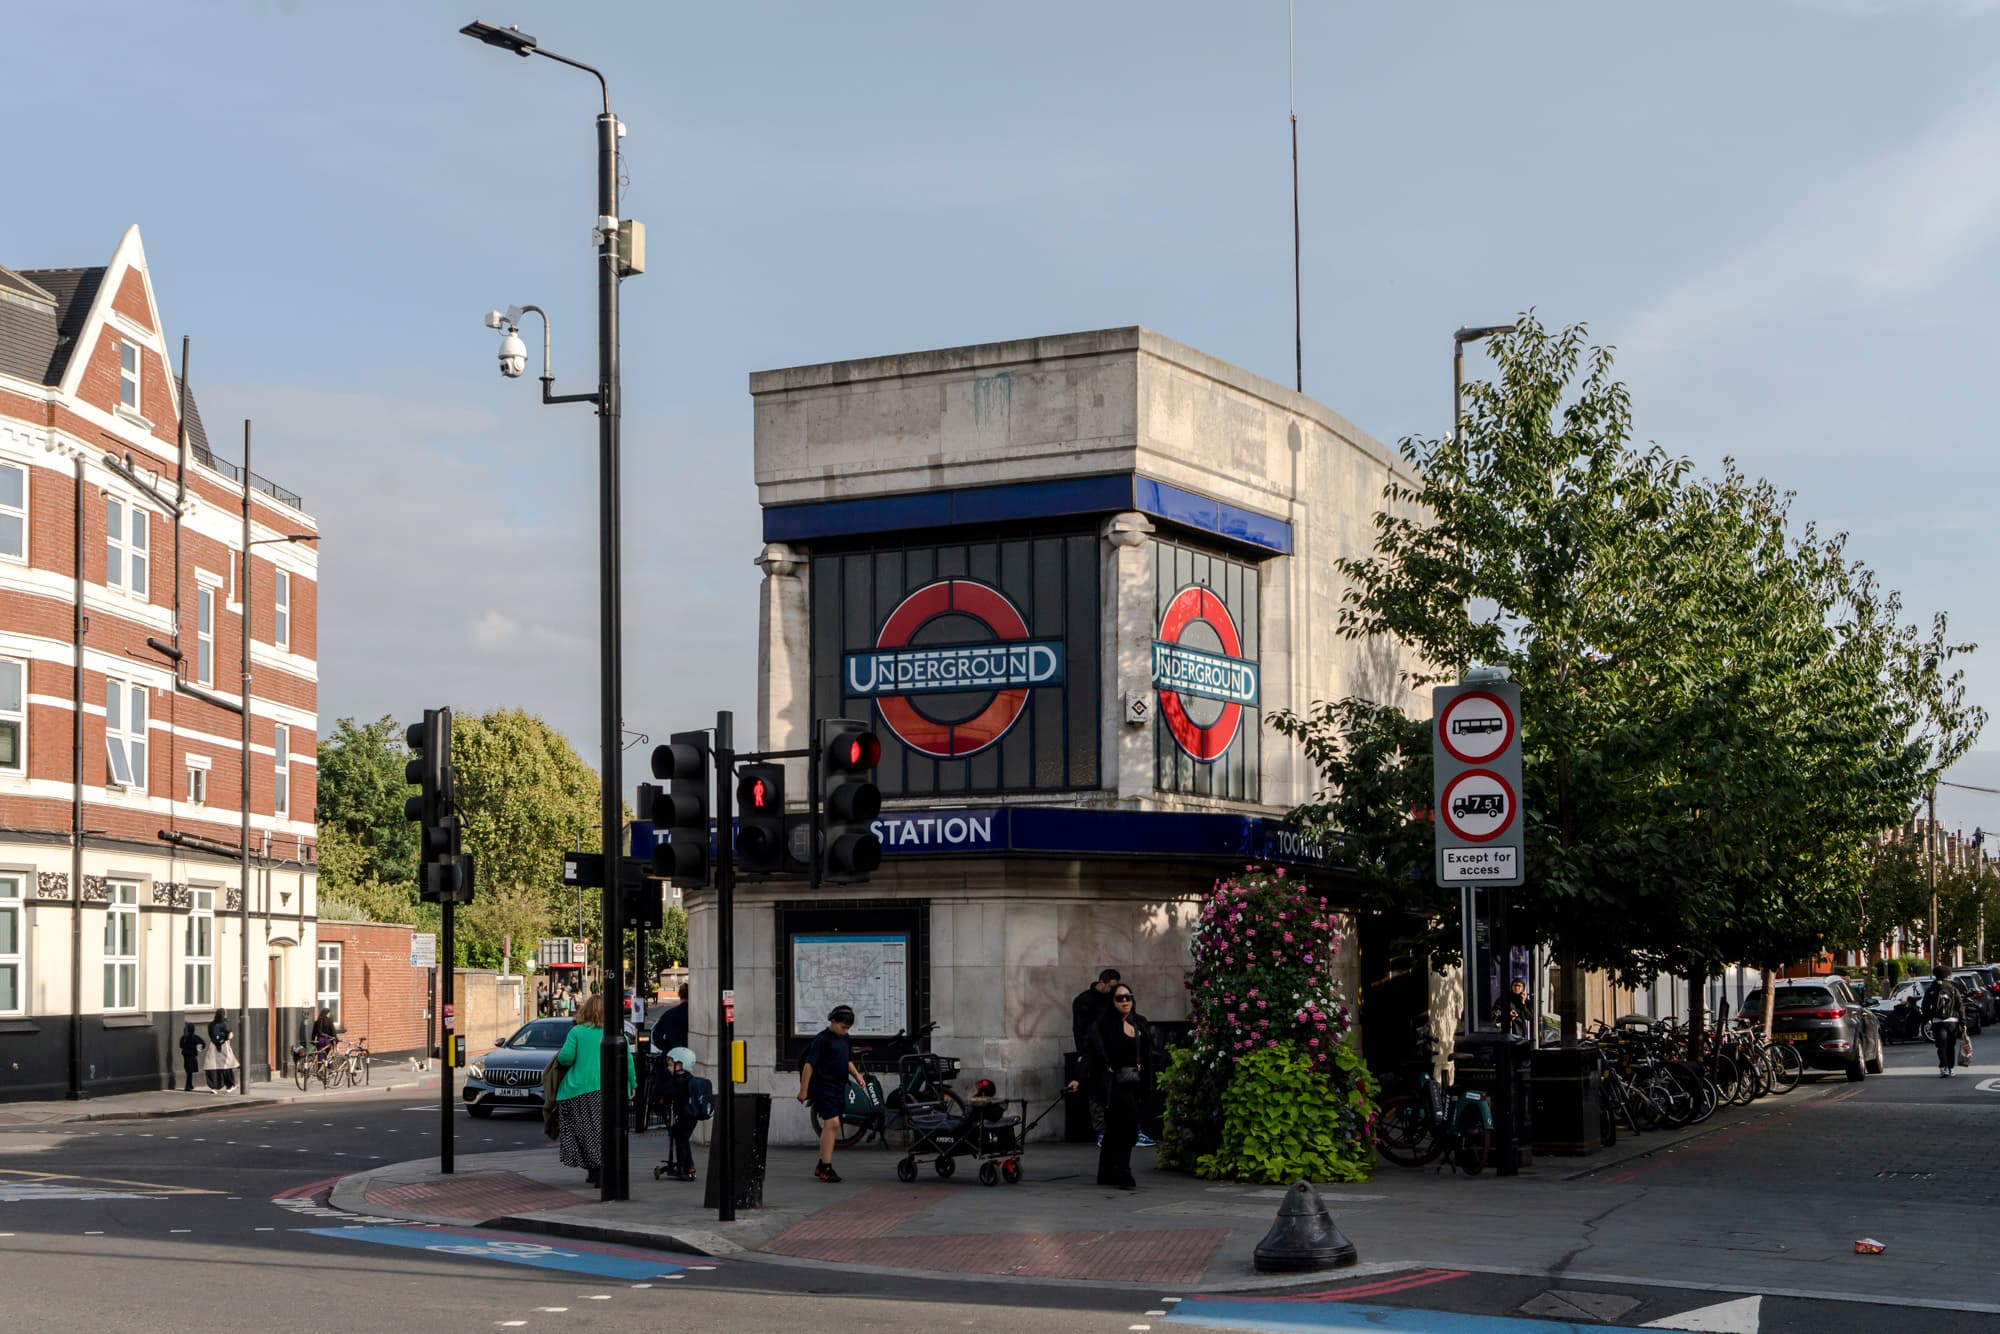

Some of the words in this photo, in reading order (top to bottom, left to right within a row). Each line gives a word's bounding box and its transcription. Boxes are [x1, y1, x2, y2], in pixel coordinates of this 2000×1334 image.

[850, 645, 1057, 692] UNDERGROUND
[870, 817, 991, 845] STATION
[1447, 852, 1489, 864] Except
[1494, 852, 1511, 862] for
[1459, 866, 1500, 875] access
